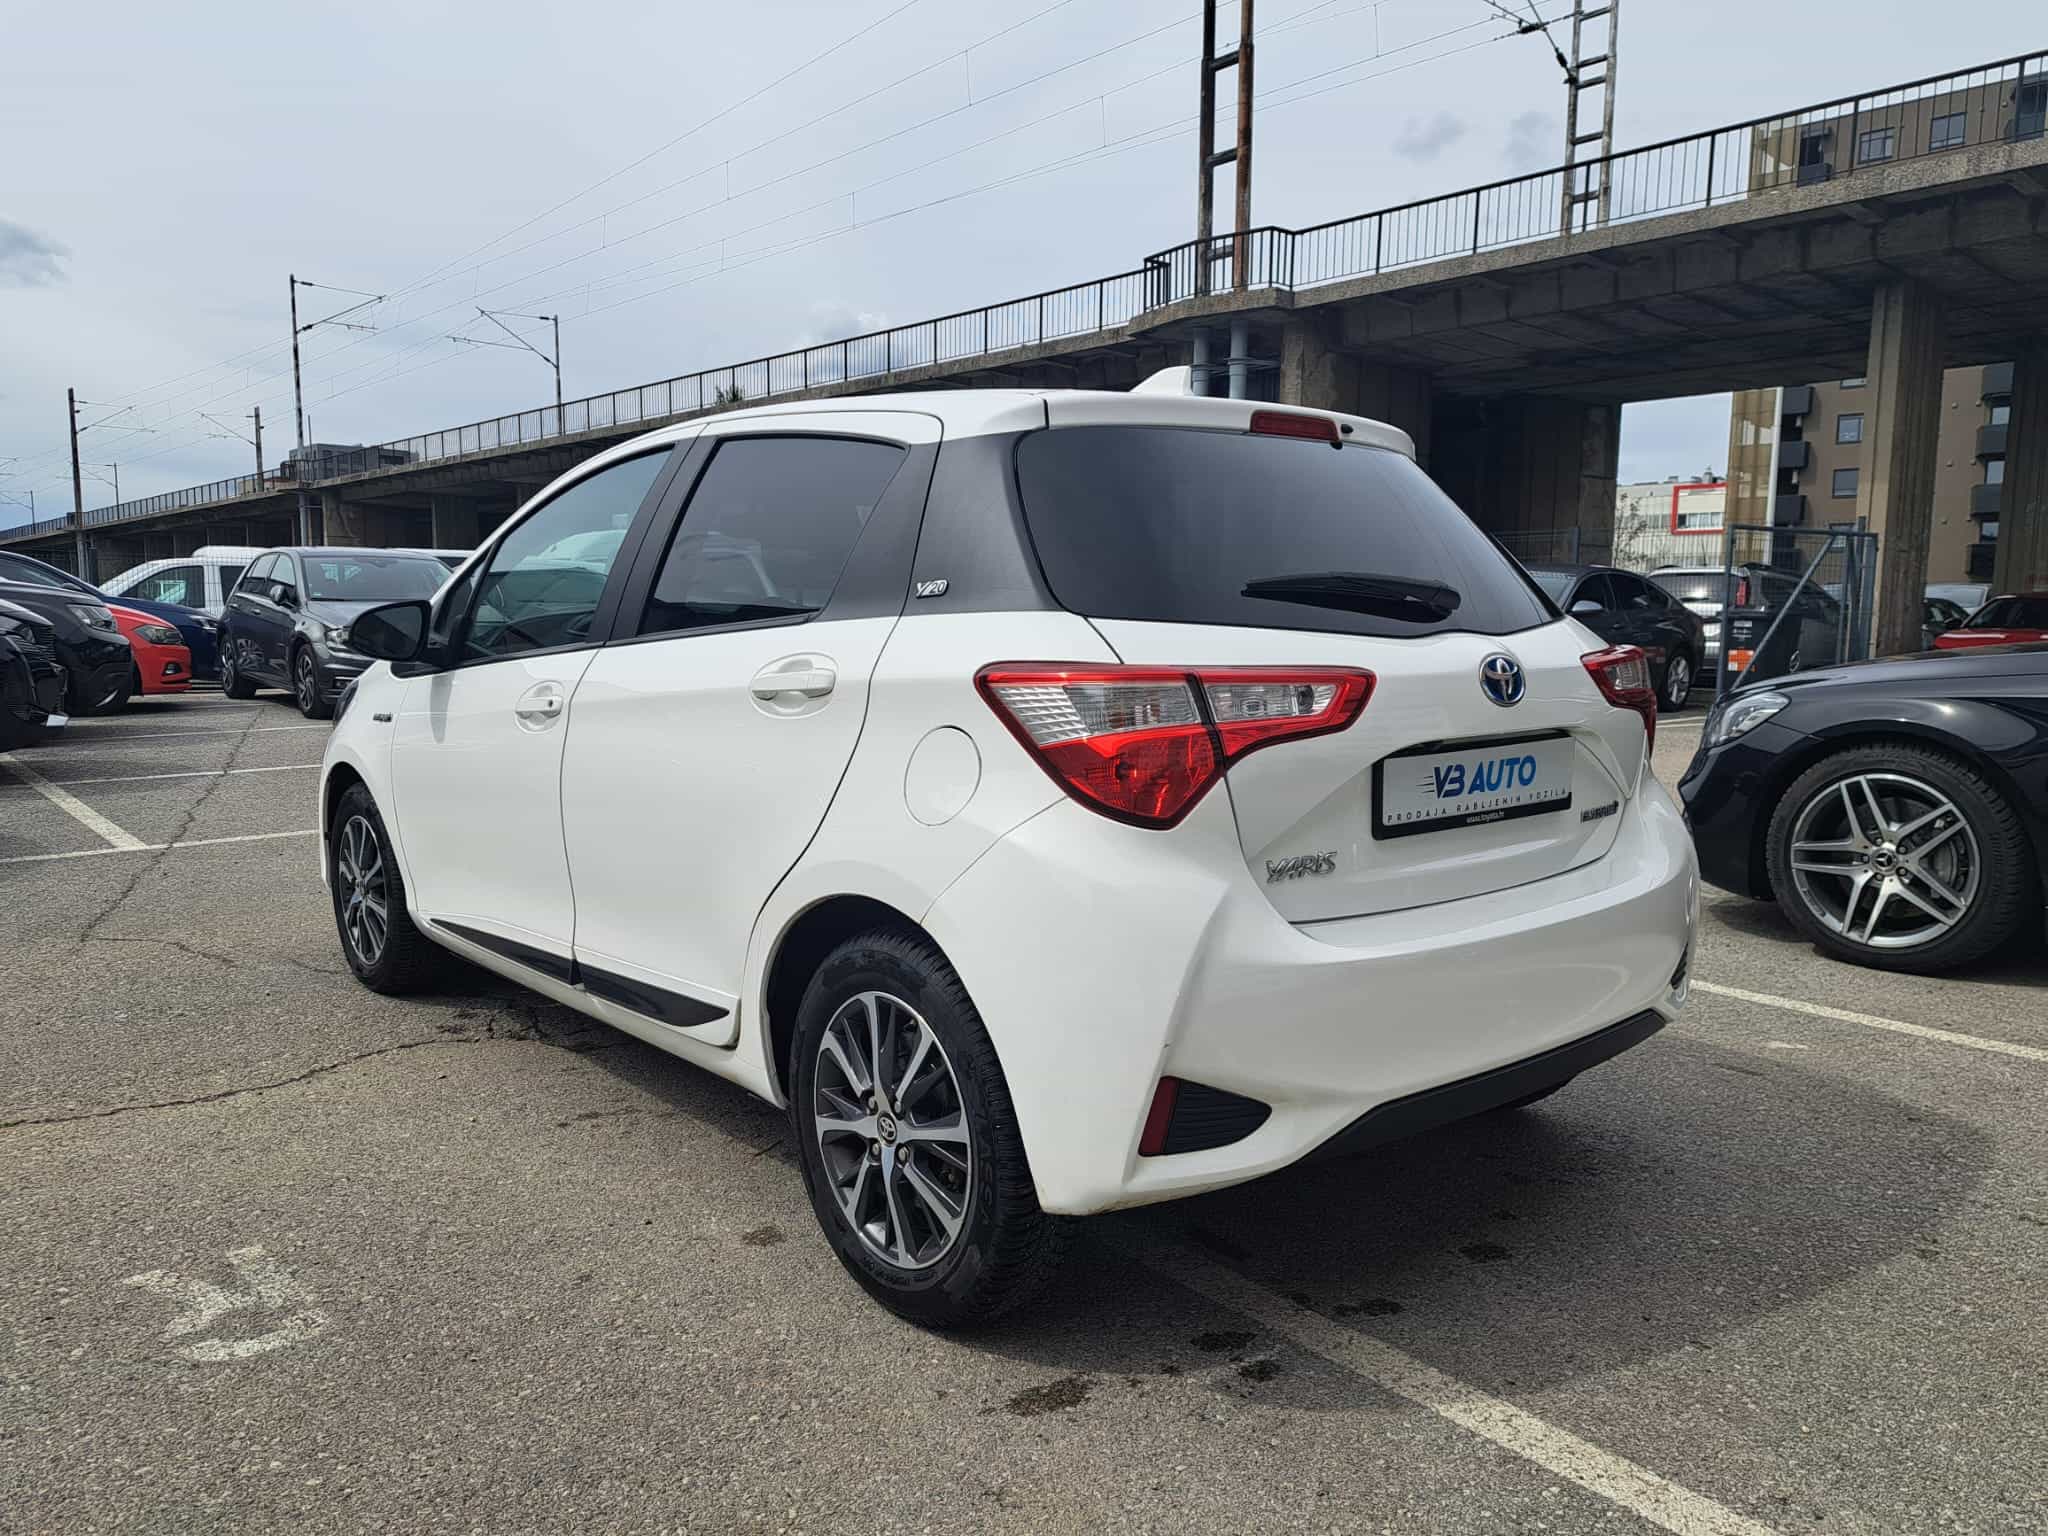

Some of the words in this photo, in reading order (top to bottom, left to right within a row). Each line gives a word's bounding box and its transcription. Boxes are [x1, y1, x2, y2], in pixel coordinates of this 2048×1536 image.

[1433, 763, 1466, 799] VB
[1468, 754, 1537, 795] AUTO
[1387, 807, 1447, 824] PRODAJA
[1265, 851, 1338, 884] YARIS
